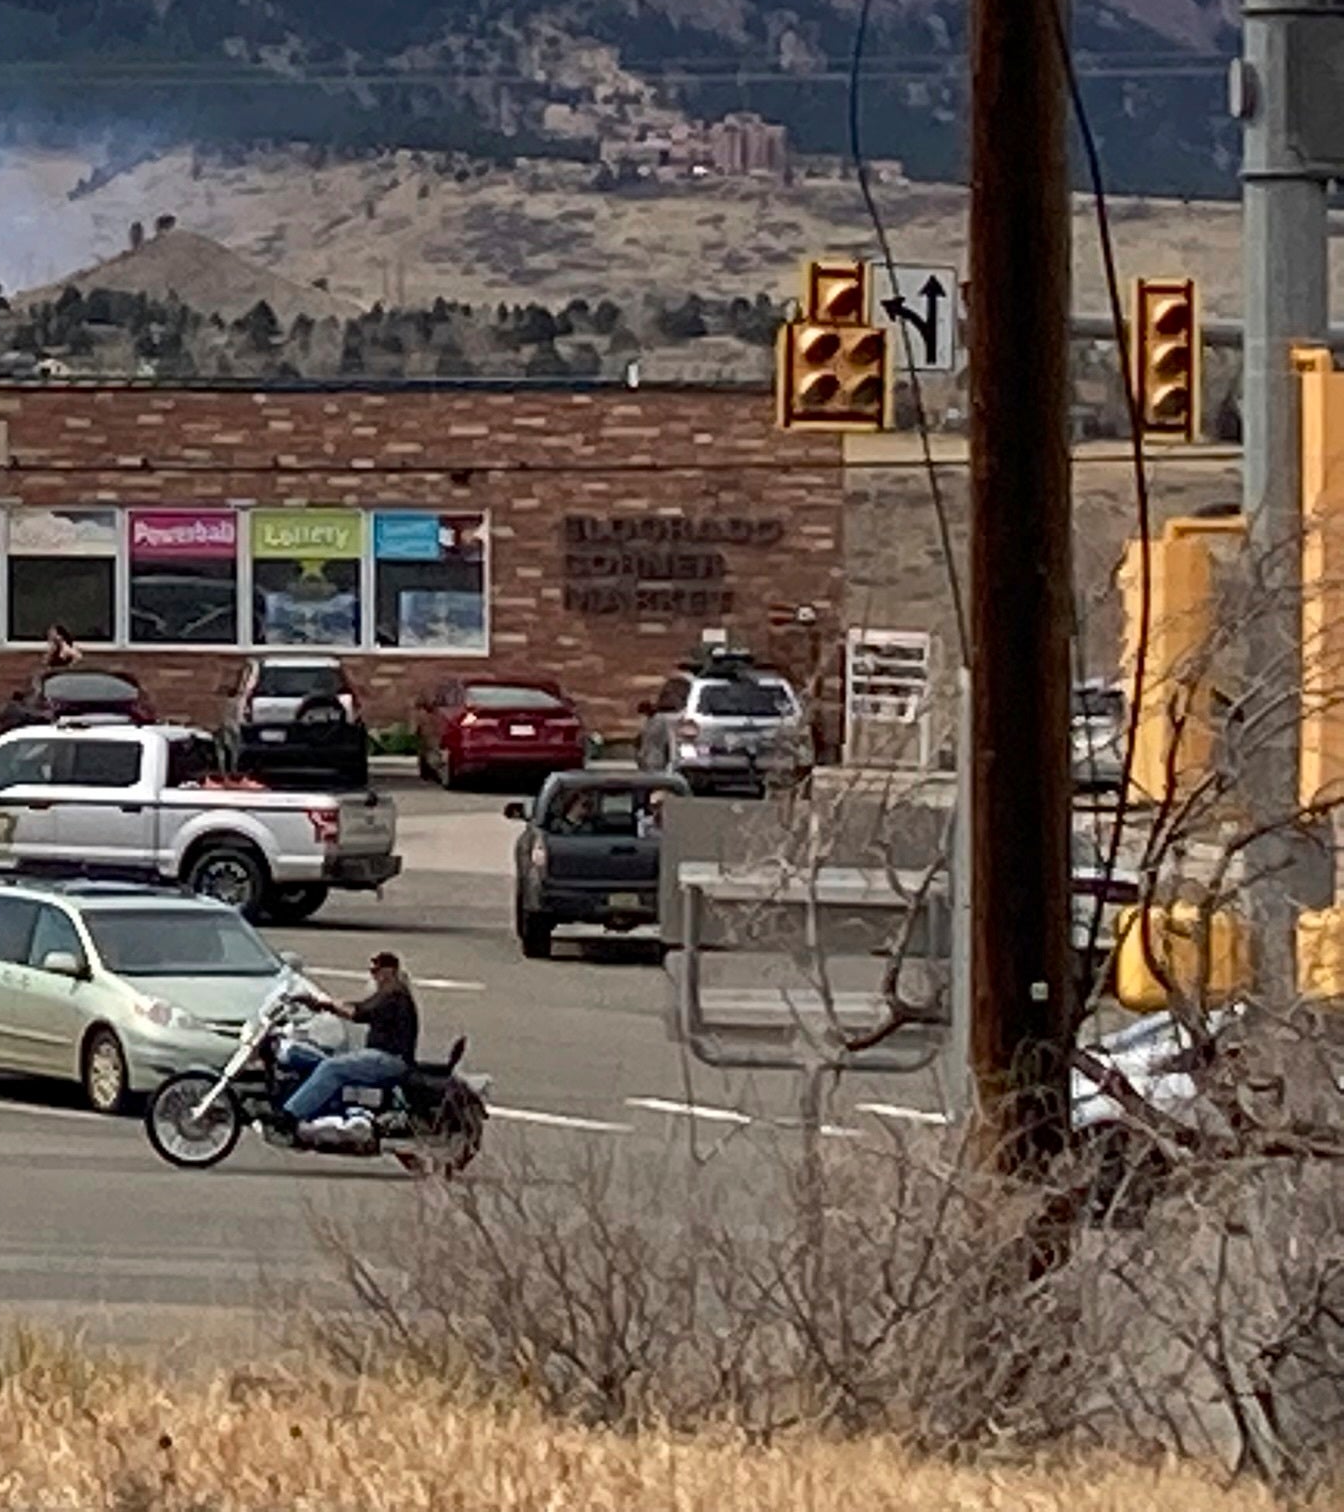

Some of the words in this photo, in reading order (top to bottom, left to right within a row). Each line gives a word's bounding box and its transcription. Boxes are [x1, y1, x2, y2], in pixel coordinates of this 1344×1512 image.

[134, 520, 235, 546] Powerball
[263, 524, 350, 549] Lottery
[564, 516, 784, 544] ELDORADO
[564, 553, 730, 580] CORNER
